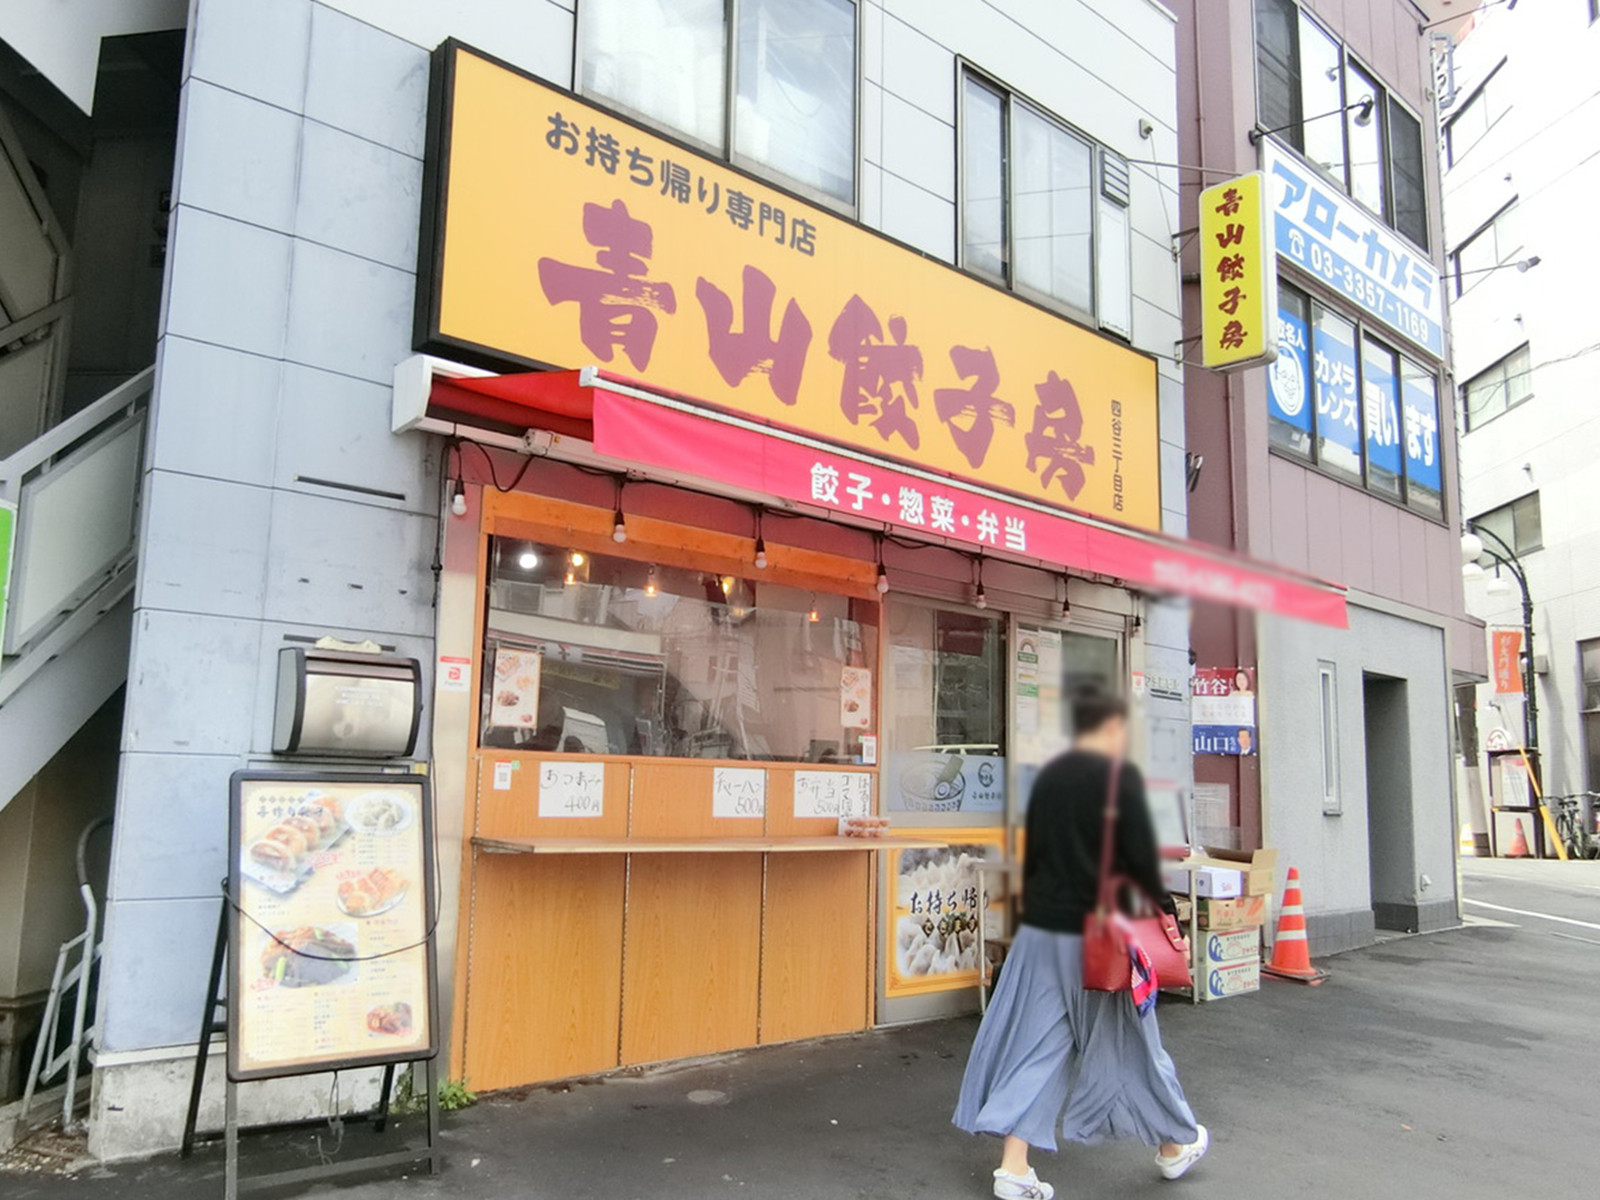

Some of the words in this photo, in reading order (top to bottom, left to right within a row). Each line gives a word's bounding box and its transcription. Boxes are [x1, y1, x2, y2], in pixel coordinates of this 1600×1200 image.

[545, 112, 817, 257] お持ち帰り専門店
[1271, 159, 1435, 310] アローカメラ
[1215, 187, 1248, 351] 青山餃子房
[1311, 243, 1428, 344] 03-3357-1169
[537, 198, 1096, 502] 青山餃子房
[1315, 350, 1356, 395] カメラ
[809, 462, 1027, 553] 餃子・惣菜・弁当
[1111, 399, 1123, 512] 四谷三丁目店
[1194, 735, 1229, 752] 山口
